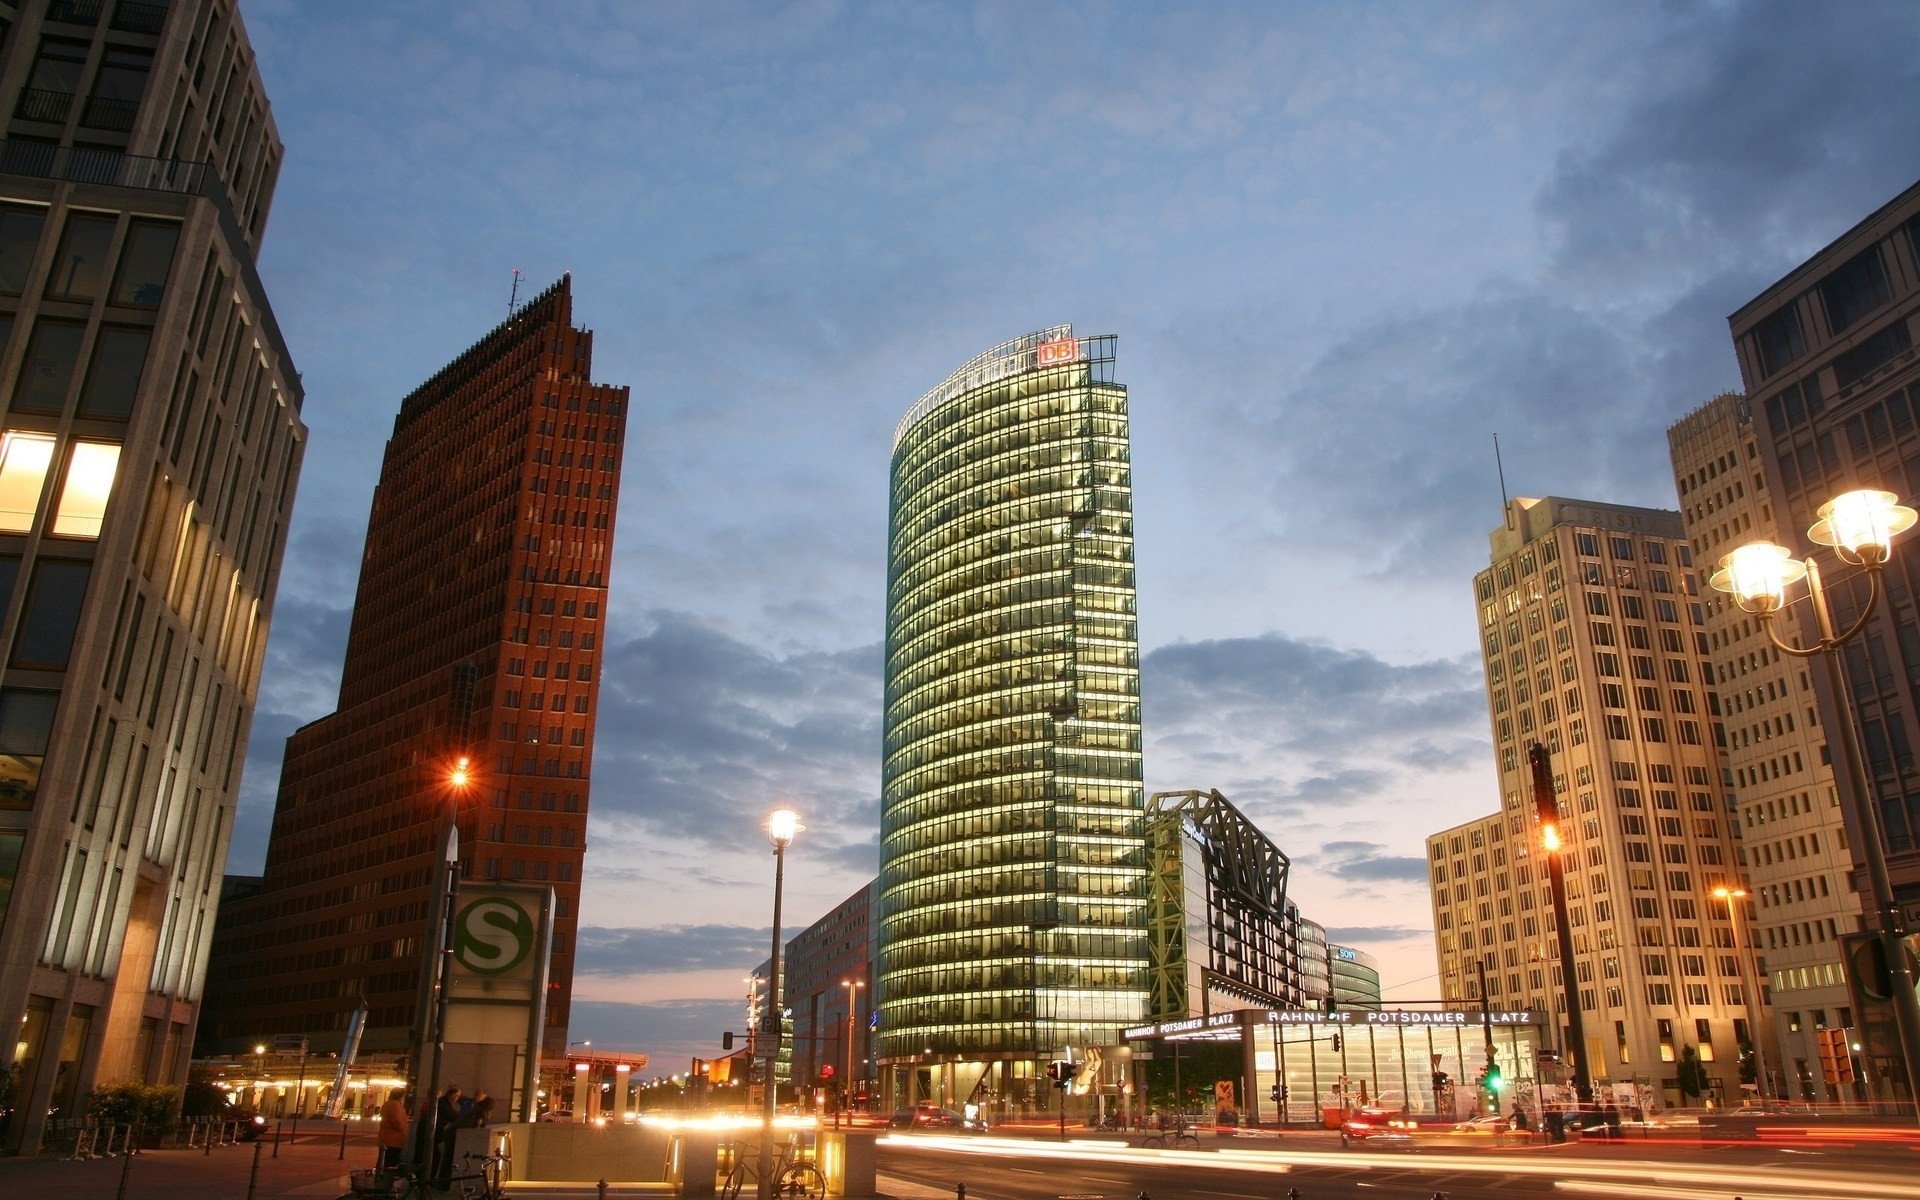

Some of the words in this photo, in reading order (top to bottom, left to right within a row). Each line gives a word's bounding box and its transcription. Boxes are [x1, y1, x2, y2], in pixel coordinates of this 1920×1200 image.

[463, 903, 520, 969] S
[1339, 948, 1355, 959] SONY
[1125, 1026, 1156, 1038] BAHNHOF
[1160, 1019, 1202, 1033] POTSDAMER
[1208, 1013, 1234, 1026] PLATZ
[1268, 1012, 1351, 1022] BAHNHF
[1367, 1012, 1466, 1022] POTSDAMER
